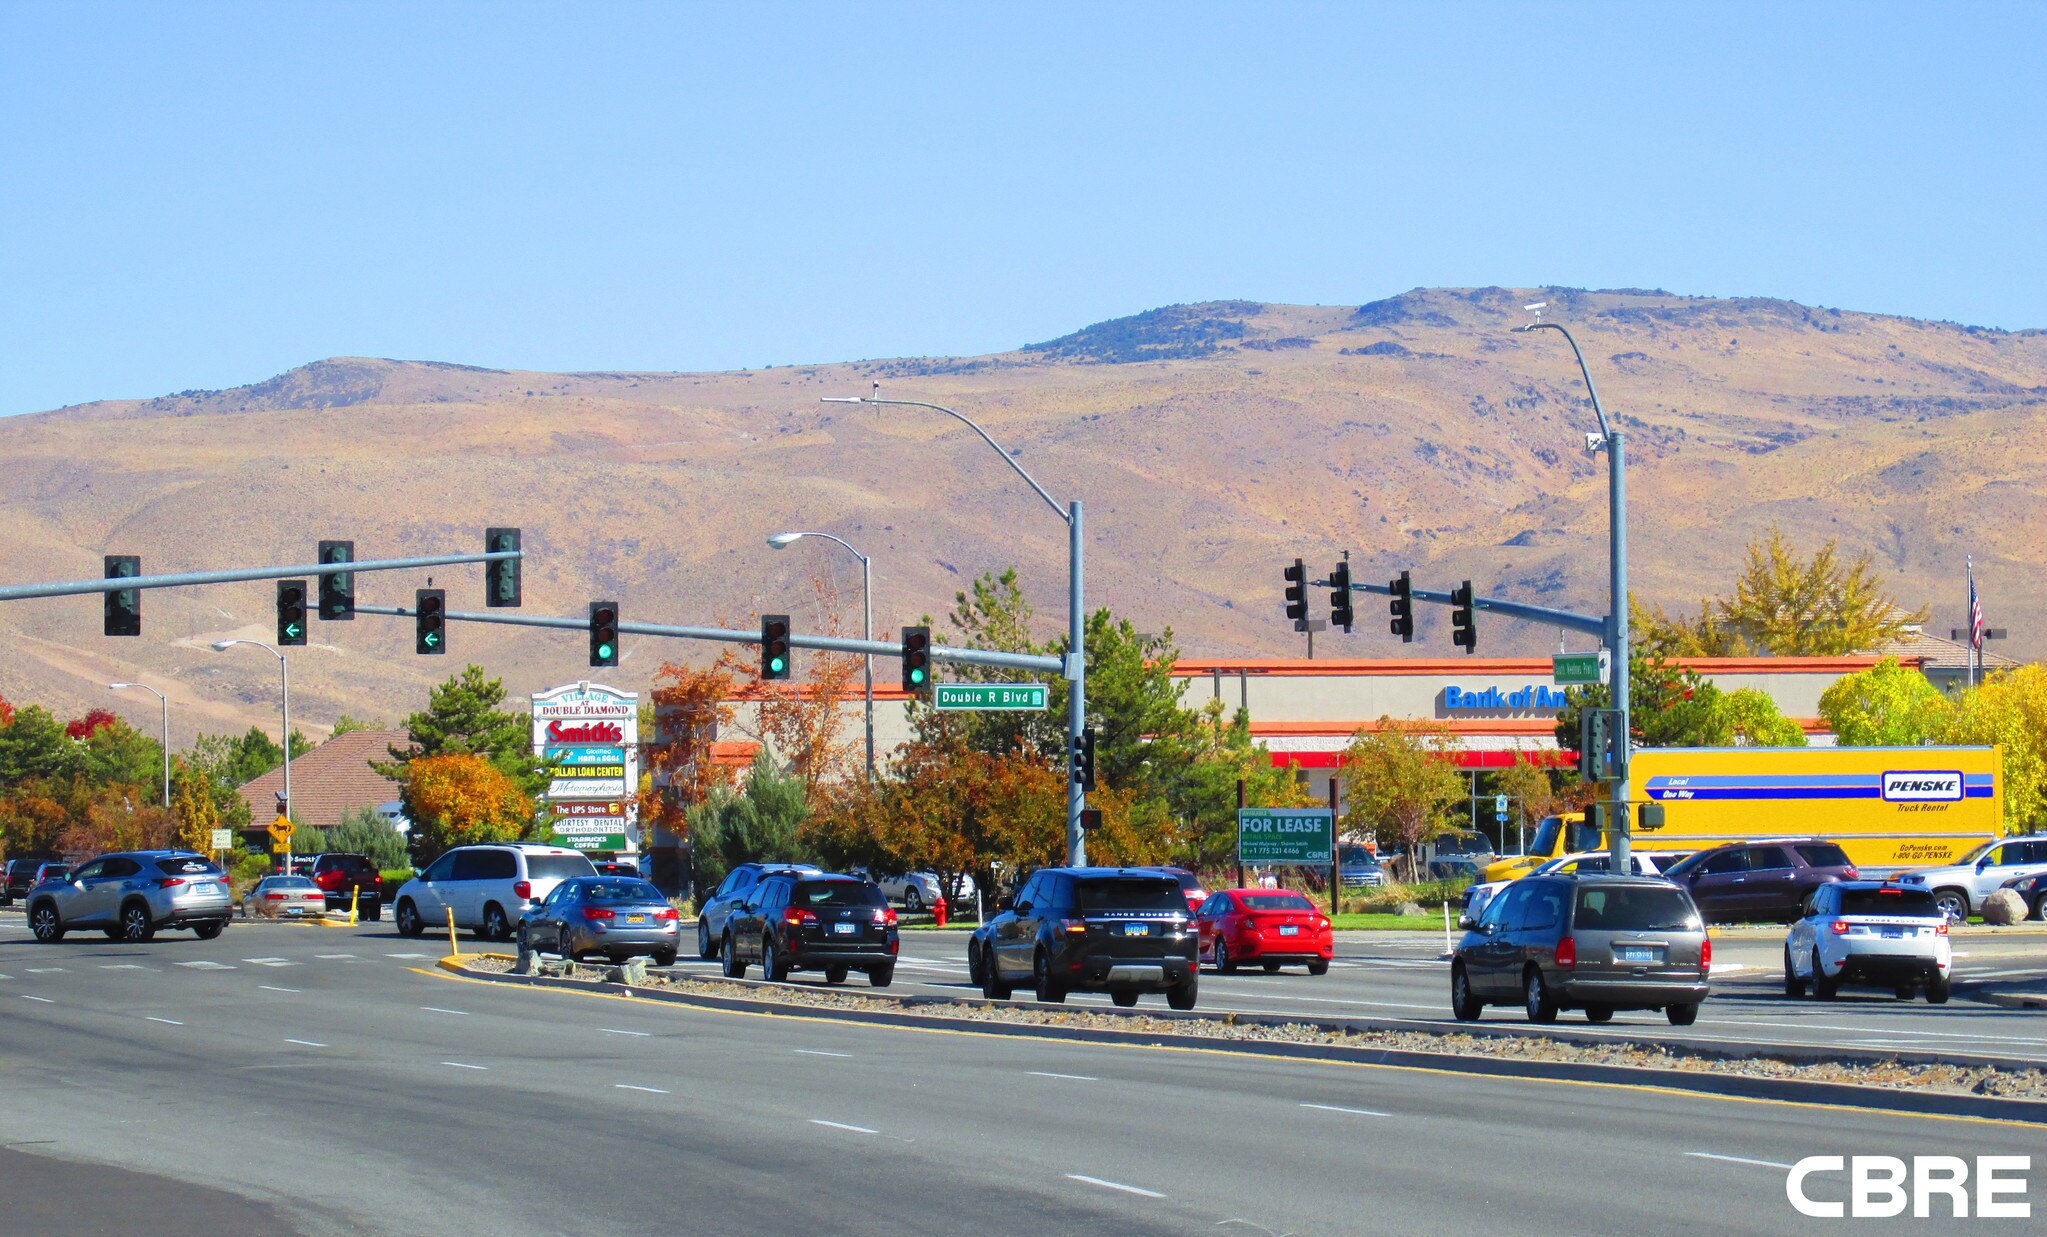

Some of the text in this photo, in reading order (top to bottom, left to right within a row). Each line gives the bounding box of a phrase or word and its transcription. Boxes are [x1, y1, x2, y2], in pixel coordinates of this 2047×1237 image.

[561, 691, 609, 704] VILLAGE
[942, 691, 1028, 702] Double R Blvd
[1445, 685, 1567, 708] Bank of Am
[542, 705, 628, 715] DOUBLE DIAMOND
[549, 719, 622, 743] Smith's
[577, 767, 595, 777] LOAN
[596, 766, 623, 777] CENTER
[1668, 777, 1689, 785] Local
[1888, 780, 1957, 792] PENSKE
[550, 781, 623, 795] Metamorphosis
[1662, 790, 1695, 799] One Way
[556, 805, 606, 814] The UPS Store
[1897, 804, 1949, 812] Truck Rental
[554, 819, 588, 827] OURTESY
[1242, 818, 1322, 832] FOR LEASE
[1306, 851, 1329, 859] CBRE
